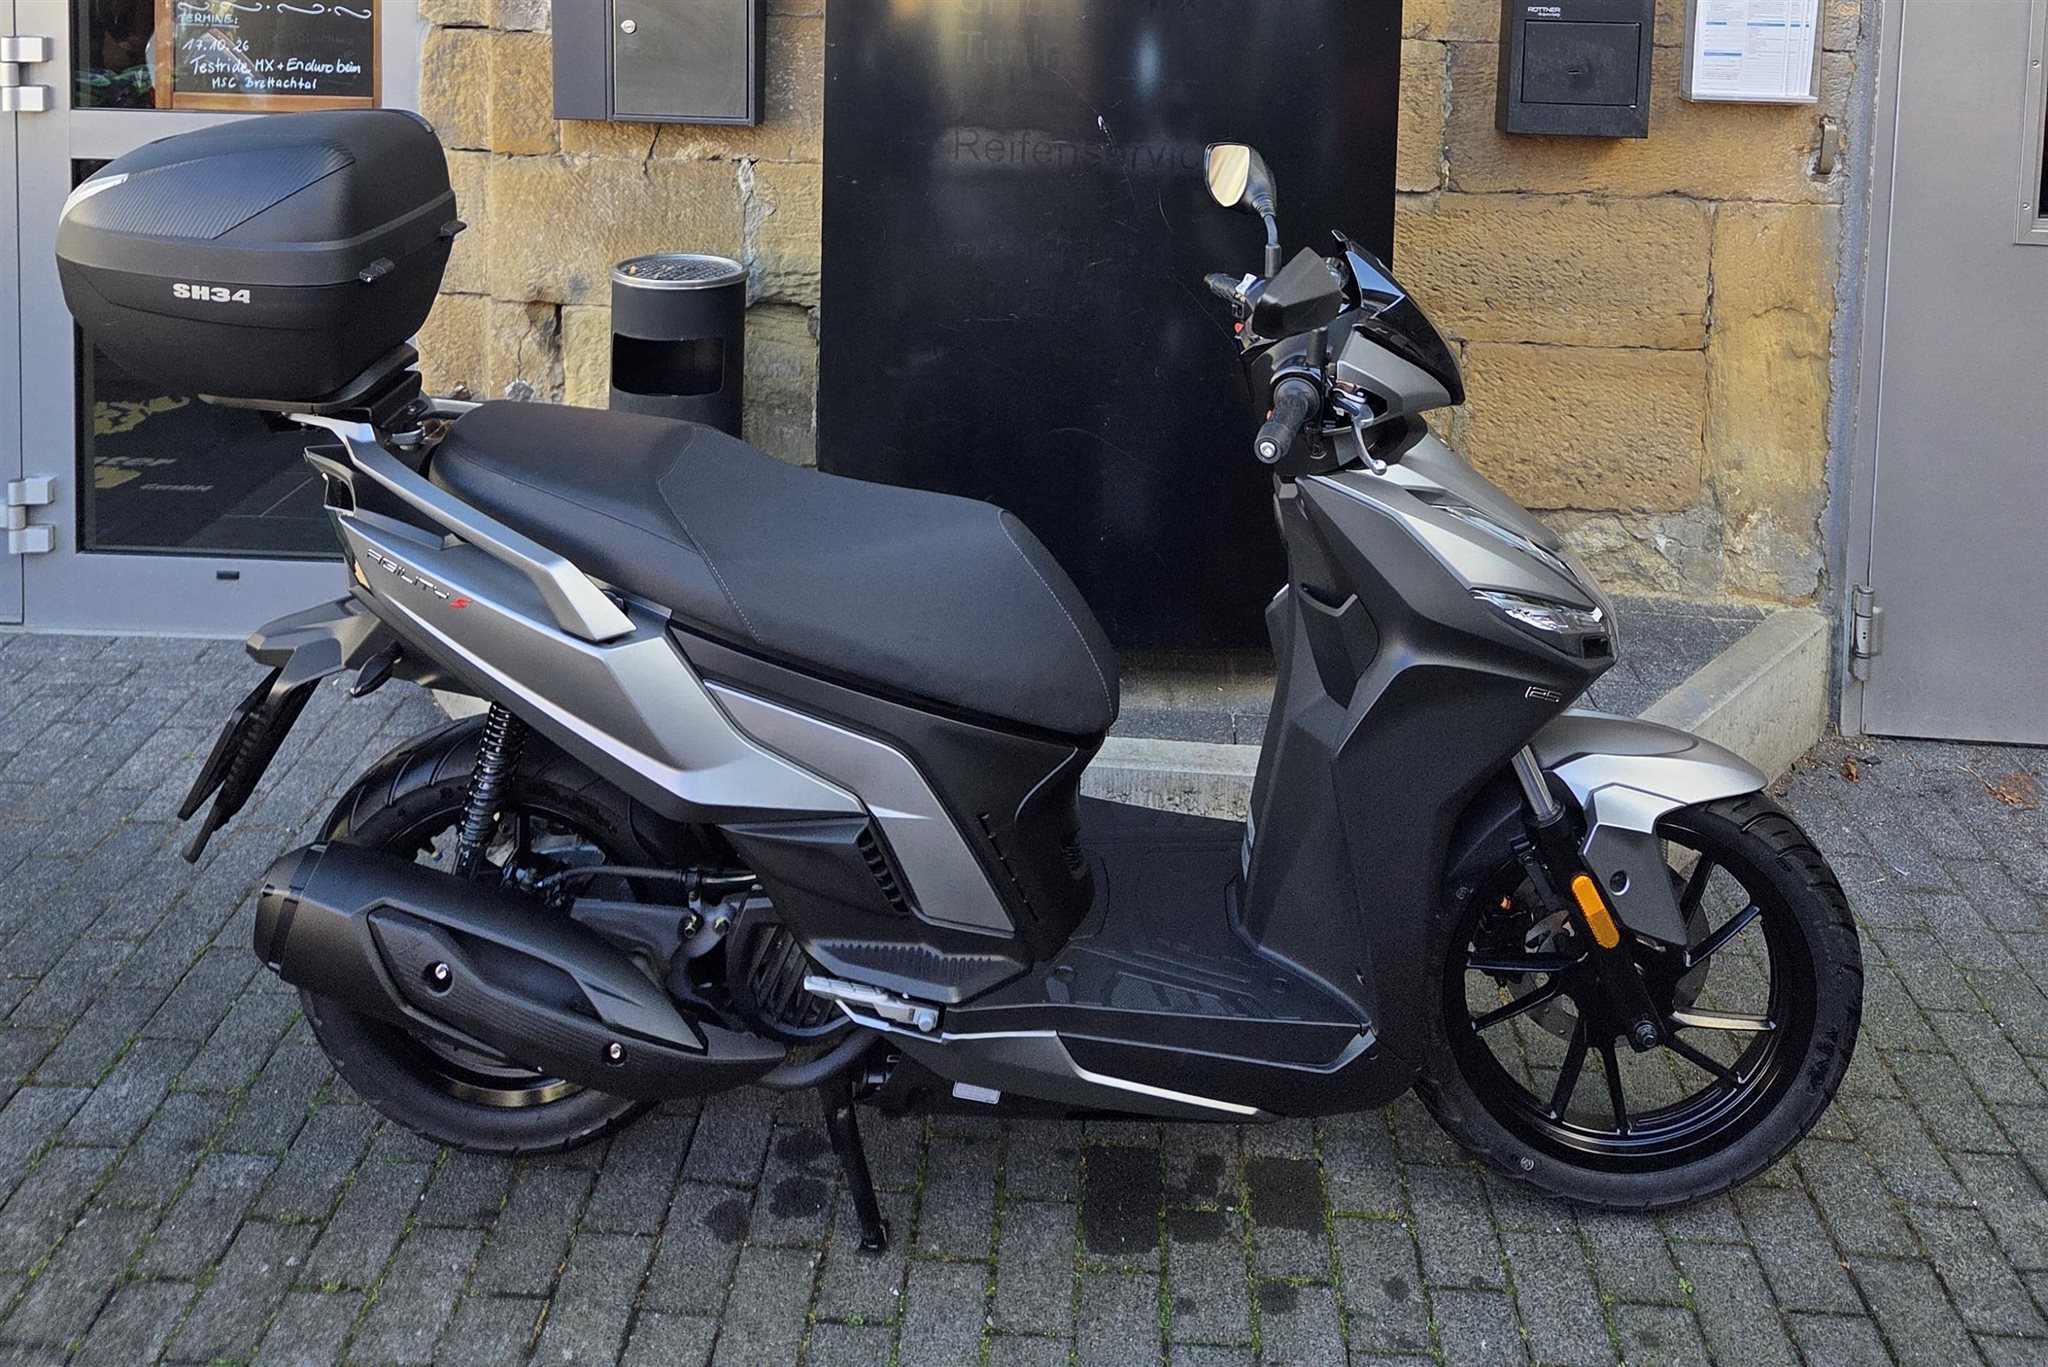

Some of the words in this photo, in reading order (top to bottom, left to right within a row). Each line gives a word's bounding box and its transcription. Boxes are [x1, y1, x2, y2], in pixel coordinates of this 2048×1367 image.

[178, 13, 239, 25] TERMINE:
[190, 54, 252, 75] Testride
[255, 58, 274, 72] MX
[276, 62, 285, 71] +
[286, 57, 334, 74] Enduro
[211, 76, 237, 89] MSC
[953, 127, 1203, 171] Reifenservic
[172, 282, 251, 304] SH34
[448, 596, 473, 609] S
